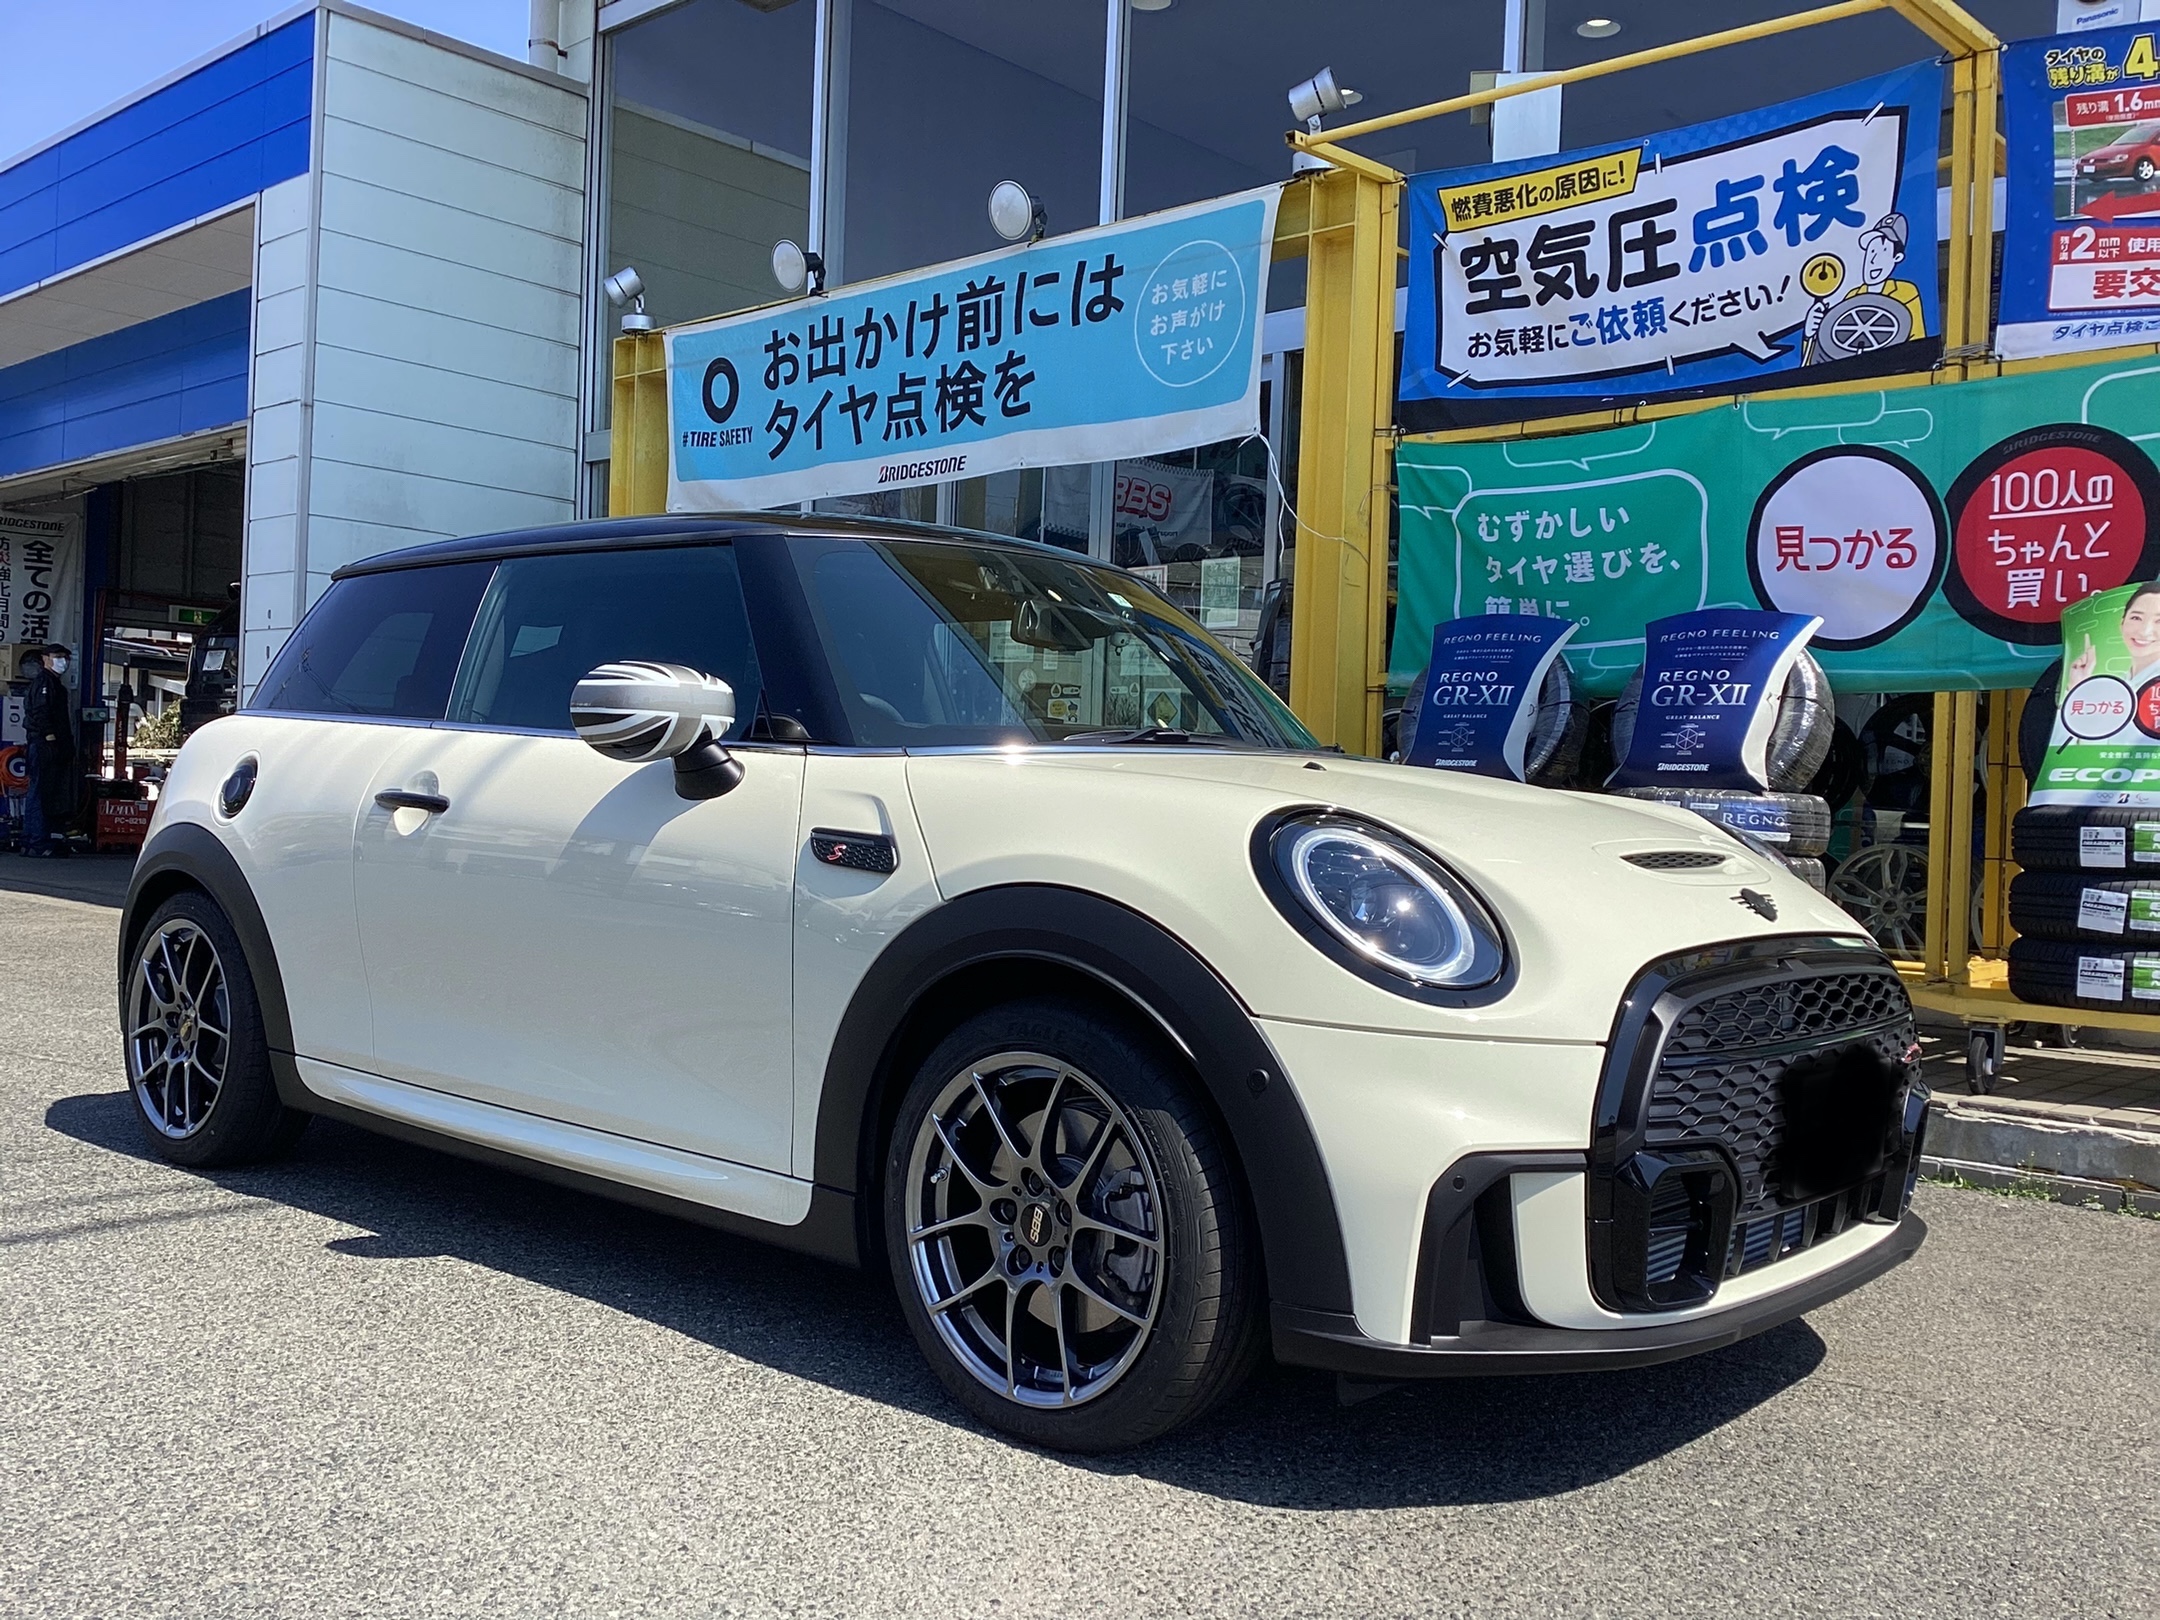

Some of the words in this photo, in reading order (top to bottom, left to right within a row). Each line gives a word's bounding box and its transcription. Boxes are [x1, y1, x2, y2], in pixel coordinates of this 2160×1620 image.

[2076, 8, 2119, 25] Panasonic
[2045, 47, 2105, 65] タイヤの
[2123, 33, 2160, 81] 4
[2049, 62, 2120, 88] 残り溝が
[2076, 101, 2109, 115] 残り溝
[1451, 160, 1626, 221] 燃費悪化の原因に!
[1459, 144, 1867, 315] 空気圧点検
[2071, 226, 2096, 259] 2
[2099, 238, 2120, 247] mm
[2098, 248, 2120, 258] 以下
[1151, 269, 1229, 305] お気軽に
[763, 253, 1126, 391] お出かけ前には
[1150, 300, 1227, 338] お声がけ
[1467, 275, 1790, 359] お気軽にご依頼ください!
[1160, 338, 1214, 366] 下さい
[764, 349, 1037, 461] タイヤ点検を
[682, 431, 717, 448] #TIRE
[719, 426, 753, 447] SAFETY
[2003, 431, 2103, 456] BRIDGESTONE
[878, 455, 967, 485] BRIDGESTONE
[1988, 468, 2114, 512] 100人の
[1477, 506, 1630, 543] むずかしい
[1775, 525, 1918, 572] 見つかる
[1987, 520, 2111, 566] ちゃんと
[1485, 542, 1681, 584] タイヤ選びを、
[1444, 634, 1482, 645] REGNO
[1485, 633, 1542, 643] FEELING
[1660, 630, 1707, 643] REGNO
[1712, 629, 1779, 640] FEELING
[1440, 671, 1498, 683] REGNO
[1659, 669, 1730, 682] REGNO
[2071, 700, 2124, 715] 見つかる
[1435, 759, 1478, 767] BRIDGESTONE
[1657, 763, 1710, 772] BRIDGESTONE
[1723, 812, 1785, 827] REGNO
[1030, 1206, 1043, 1243] BBS
